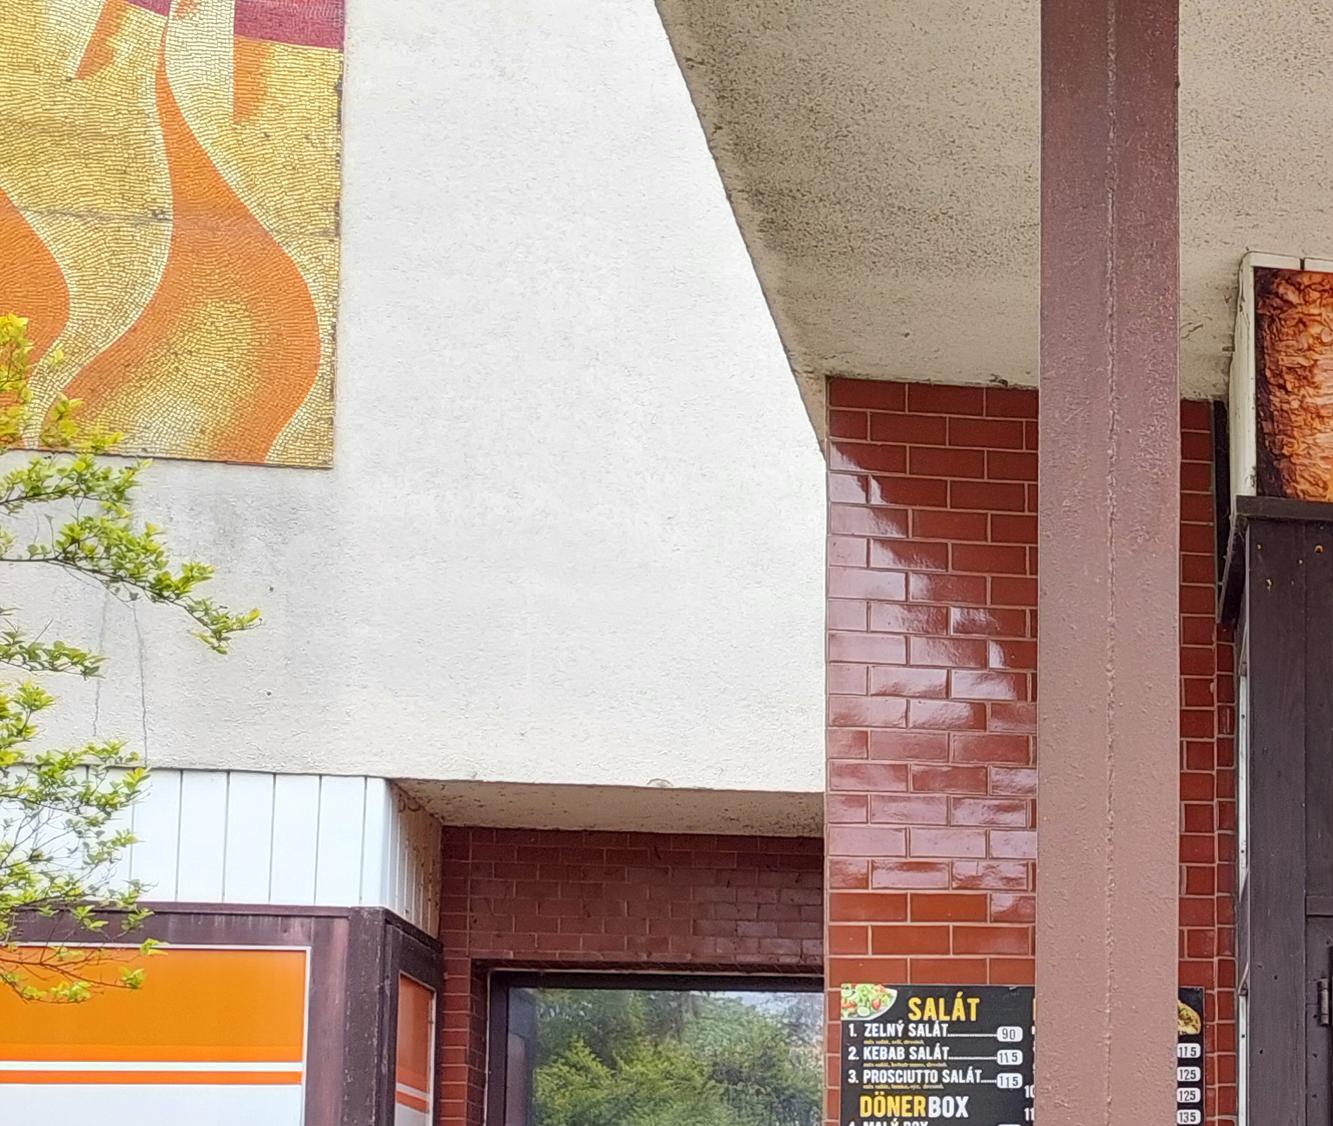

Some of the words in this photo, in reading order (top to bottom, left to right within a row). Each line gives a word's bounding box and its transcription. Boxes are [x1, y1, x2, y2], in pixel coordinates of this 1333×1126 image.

[908, 991, 980, 1021] SALÁT
[848, 1024, 857, 1037] 1.
[864, 1021, 904, 1037] ZELNÝ
[908, 1021, 948, 1037] SALÁT
[1002, 1028, 1015, 1040] 90
[848, 1047, 859, 1060] 2.
[863, 1047, 905, 1060] KEBAB
[909, 1043, 949, 1060] SALÁT
[999, 1053, 1018, 1063] 115
[1179, 1046, 1197, 1057] 115
[848, 1070, 859, 1083] 3.
[863, 1070, 938, 1084] PROSCIUTTO
[942, 1067, 982, 1084] SALÁT
[1179, 1069, 1196, 1080] 125
[1179, 1090, 1196, 1100] 125
[1179, 1112, 1196, 1122] 135
